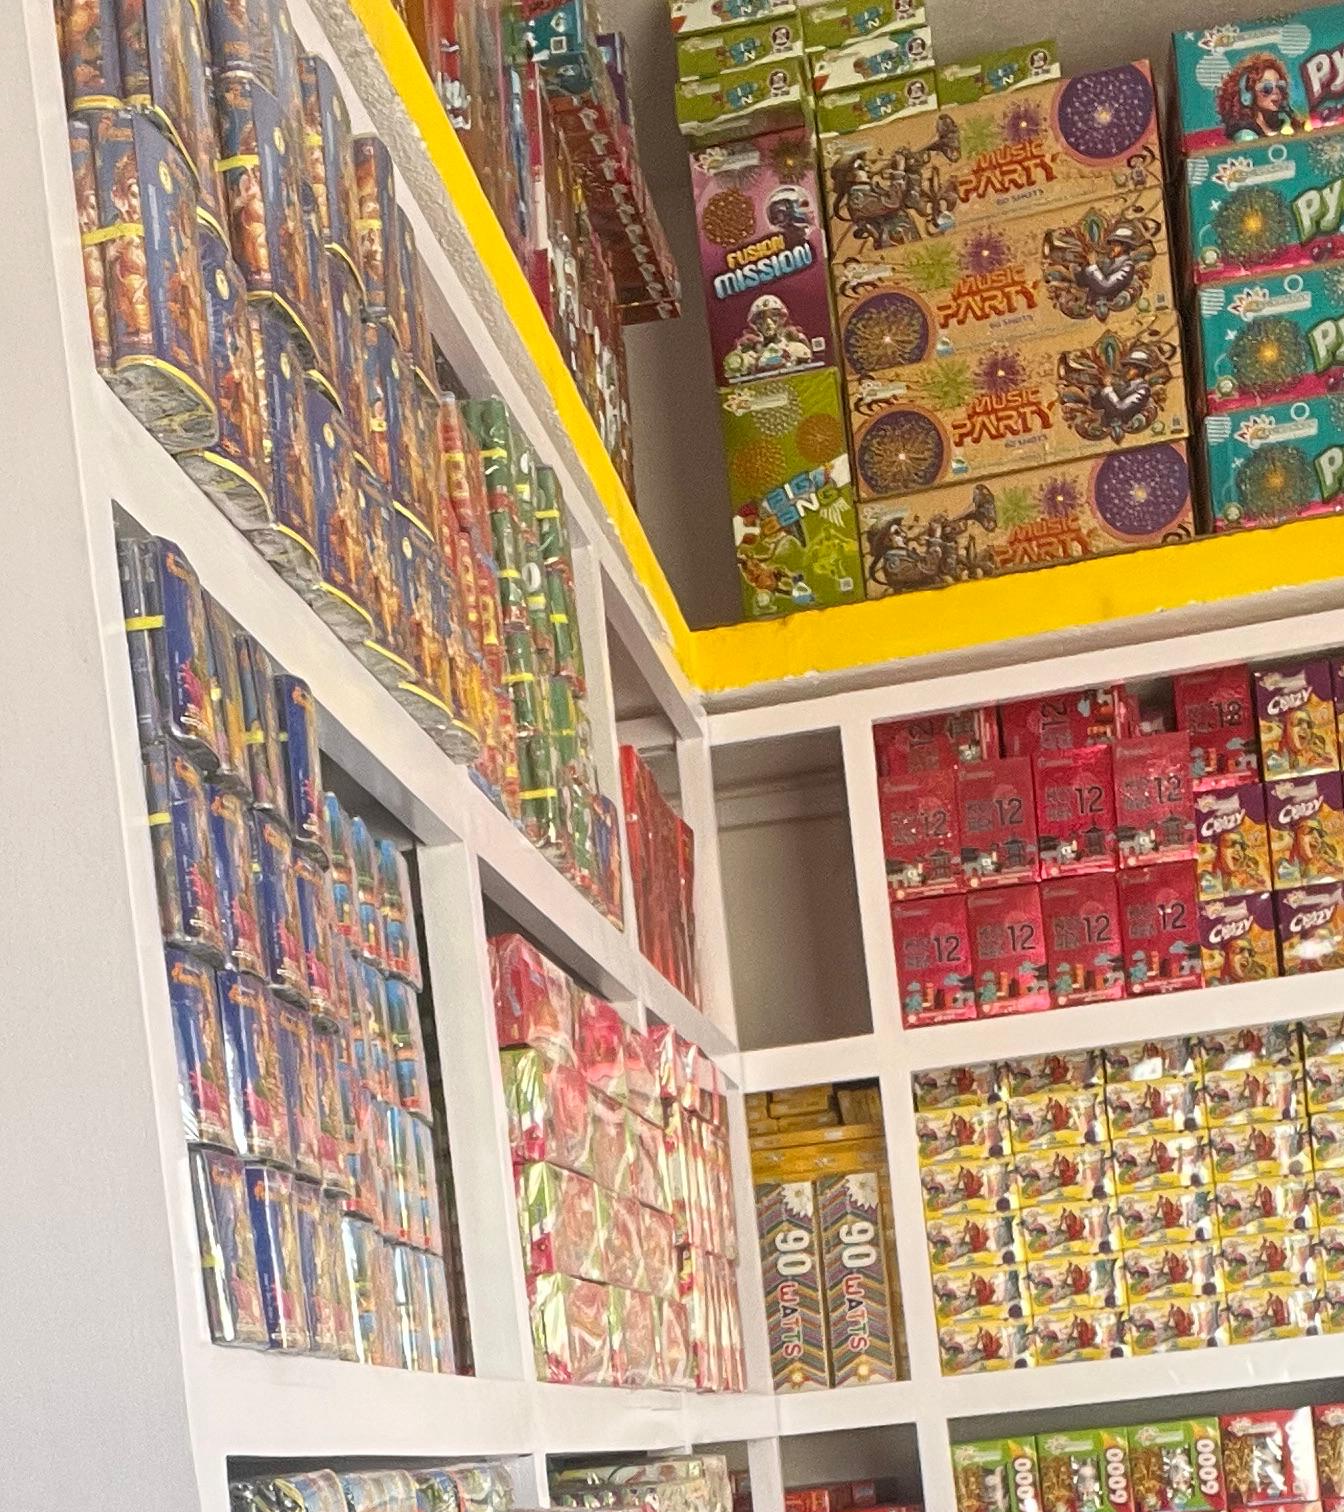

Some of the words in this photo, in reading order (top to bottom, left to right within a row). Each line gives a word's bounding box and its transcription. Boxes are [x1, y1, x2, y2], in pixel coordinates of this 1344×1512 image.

[974, 138, 1046, 171] MUSIC
[958, 153, 1058, 204] PARTY
[713, 243, 813, 299] MISSION
[952, 265, 1027, 297] MUSIC
[936, 280, 1039, 329] PARTY
[968, 387, 1041, 418] MUSIC
[952, 401, 1056, 447] PARTY
[1074, 785, 1105, 814] 12
[1153, 775, 1183, 804] 12
[920, 810, 948, 837] 12
[994, 797, 1024, 825] 12
[1082, 914, 1112, 943] 12
[1157, 902, 1187, 932] 12
[932, 935, 961, 963] 12
[1006, 923, 1036, 952] 12
[775, 1229, 813, 1277] 90
[839, 1220, 878, 1270] 90
[778, 1282, 803, 1360] WATTS
[842, 1274, 870, 1354] WATTS
[1105, 1447, 1128, 1504] 6000
[1196, 1438, 1220, 1495] 6000
